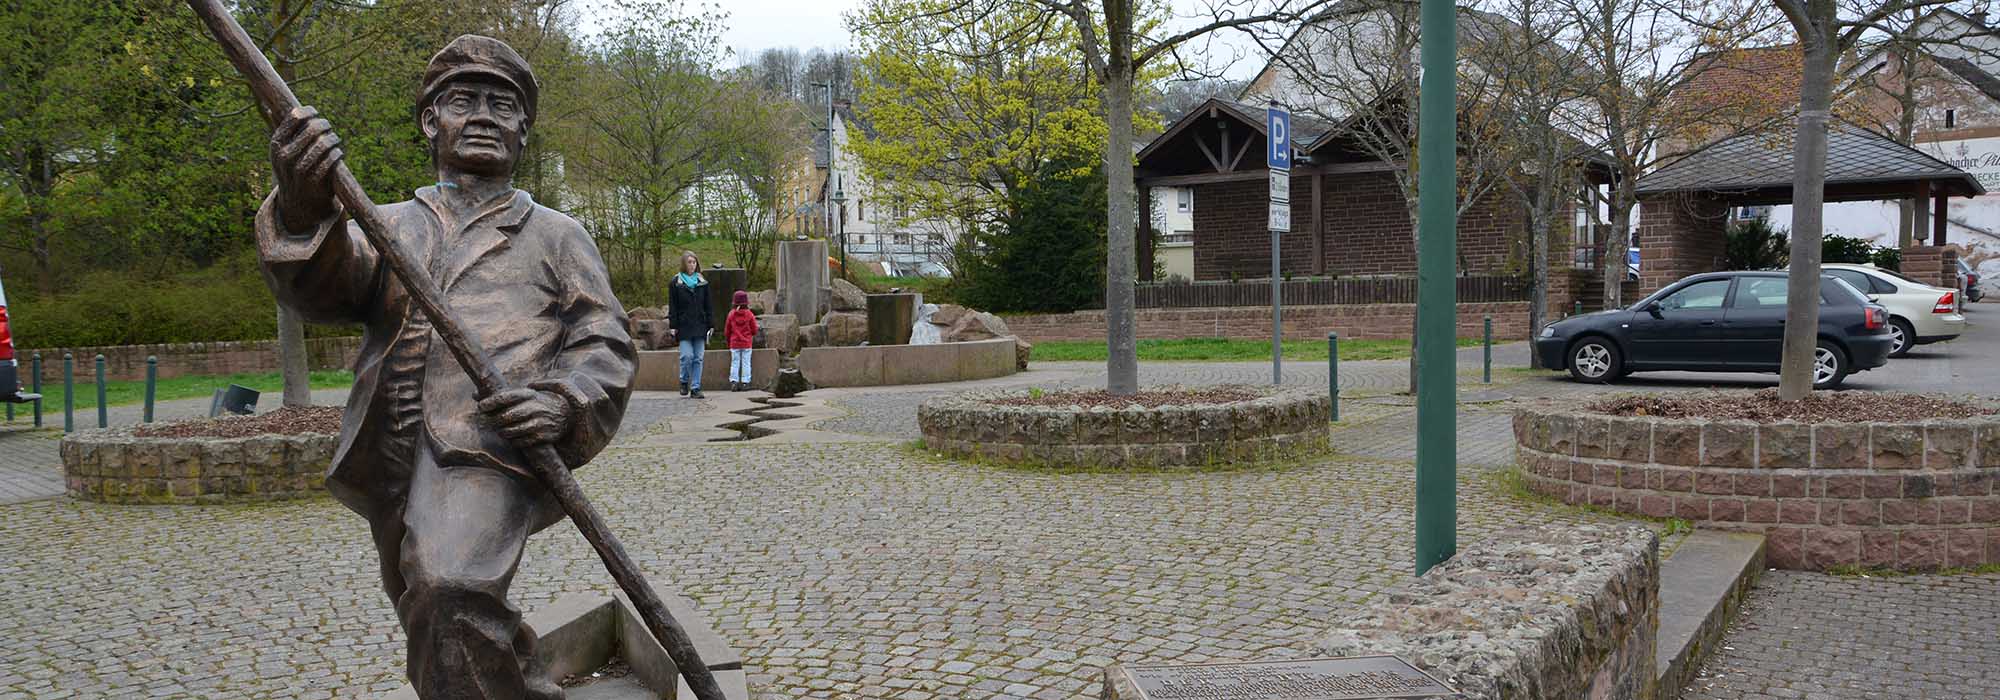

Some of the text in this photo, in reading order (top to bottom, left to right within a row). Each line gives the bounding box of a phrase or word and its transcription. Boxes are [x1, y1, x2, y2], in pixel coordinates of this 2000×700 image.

[1273, 116, 1285, 160] P
[1946, 151, 2000, 170] bacher Pil
